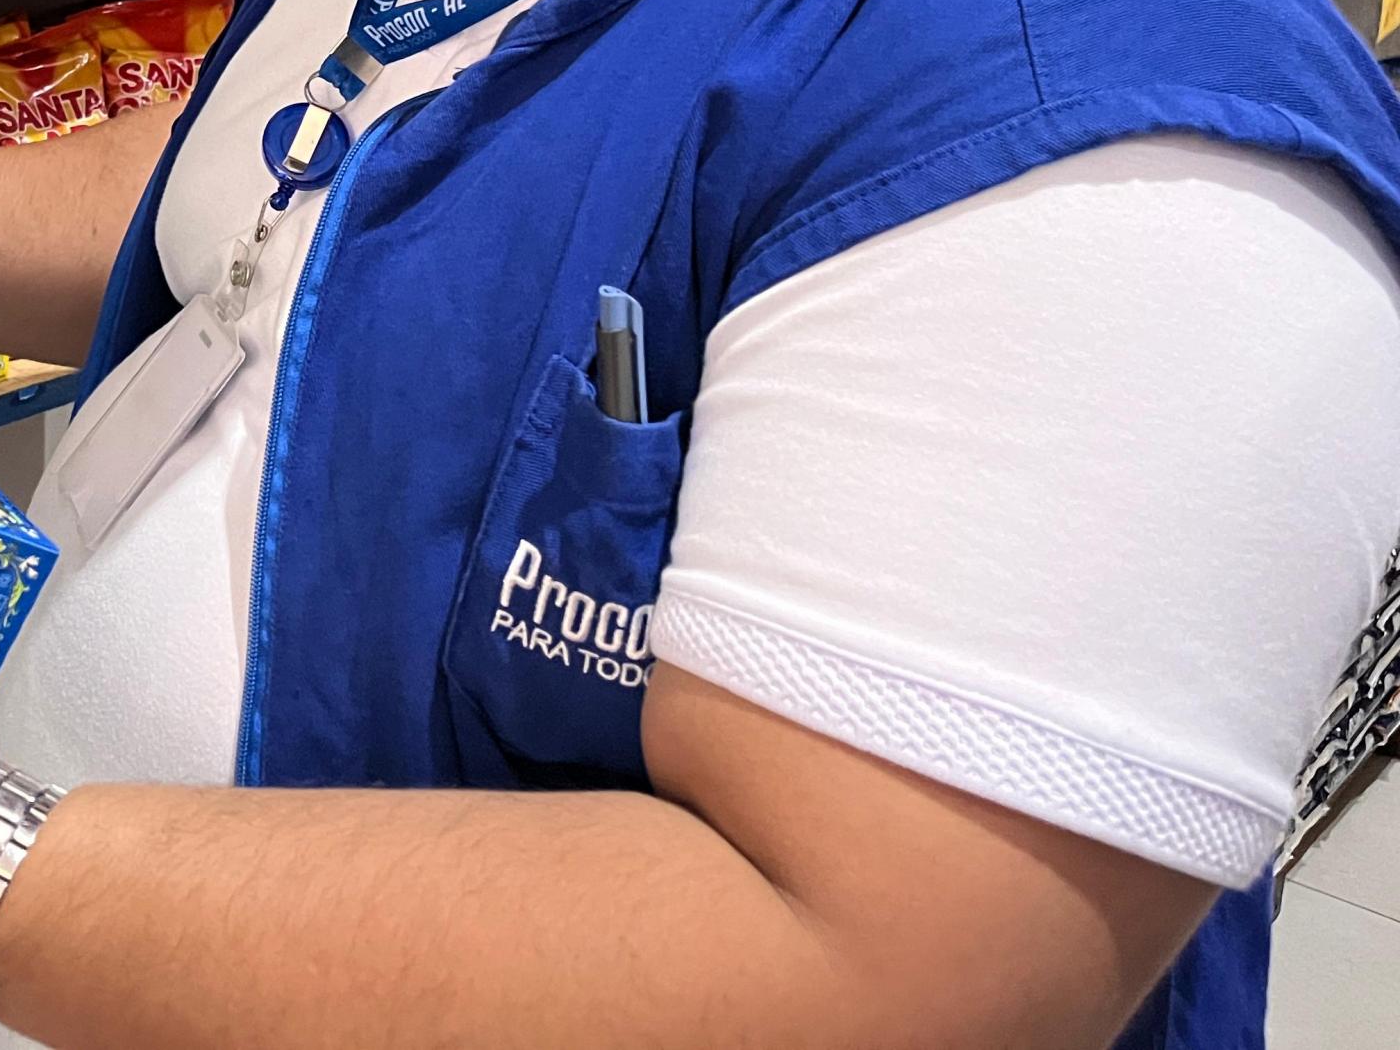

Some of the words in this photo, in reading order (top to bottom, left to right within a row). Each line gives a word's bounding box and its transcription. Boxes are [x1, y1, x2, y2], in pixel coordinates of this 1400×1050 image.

[490, 609, 570, 667] PARA
[578, 648, 653, 688] TOD
[501, 538, 656, 661] Proco
